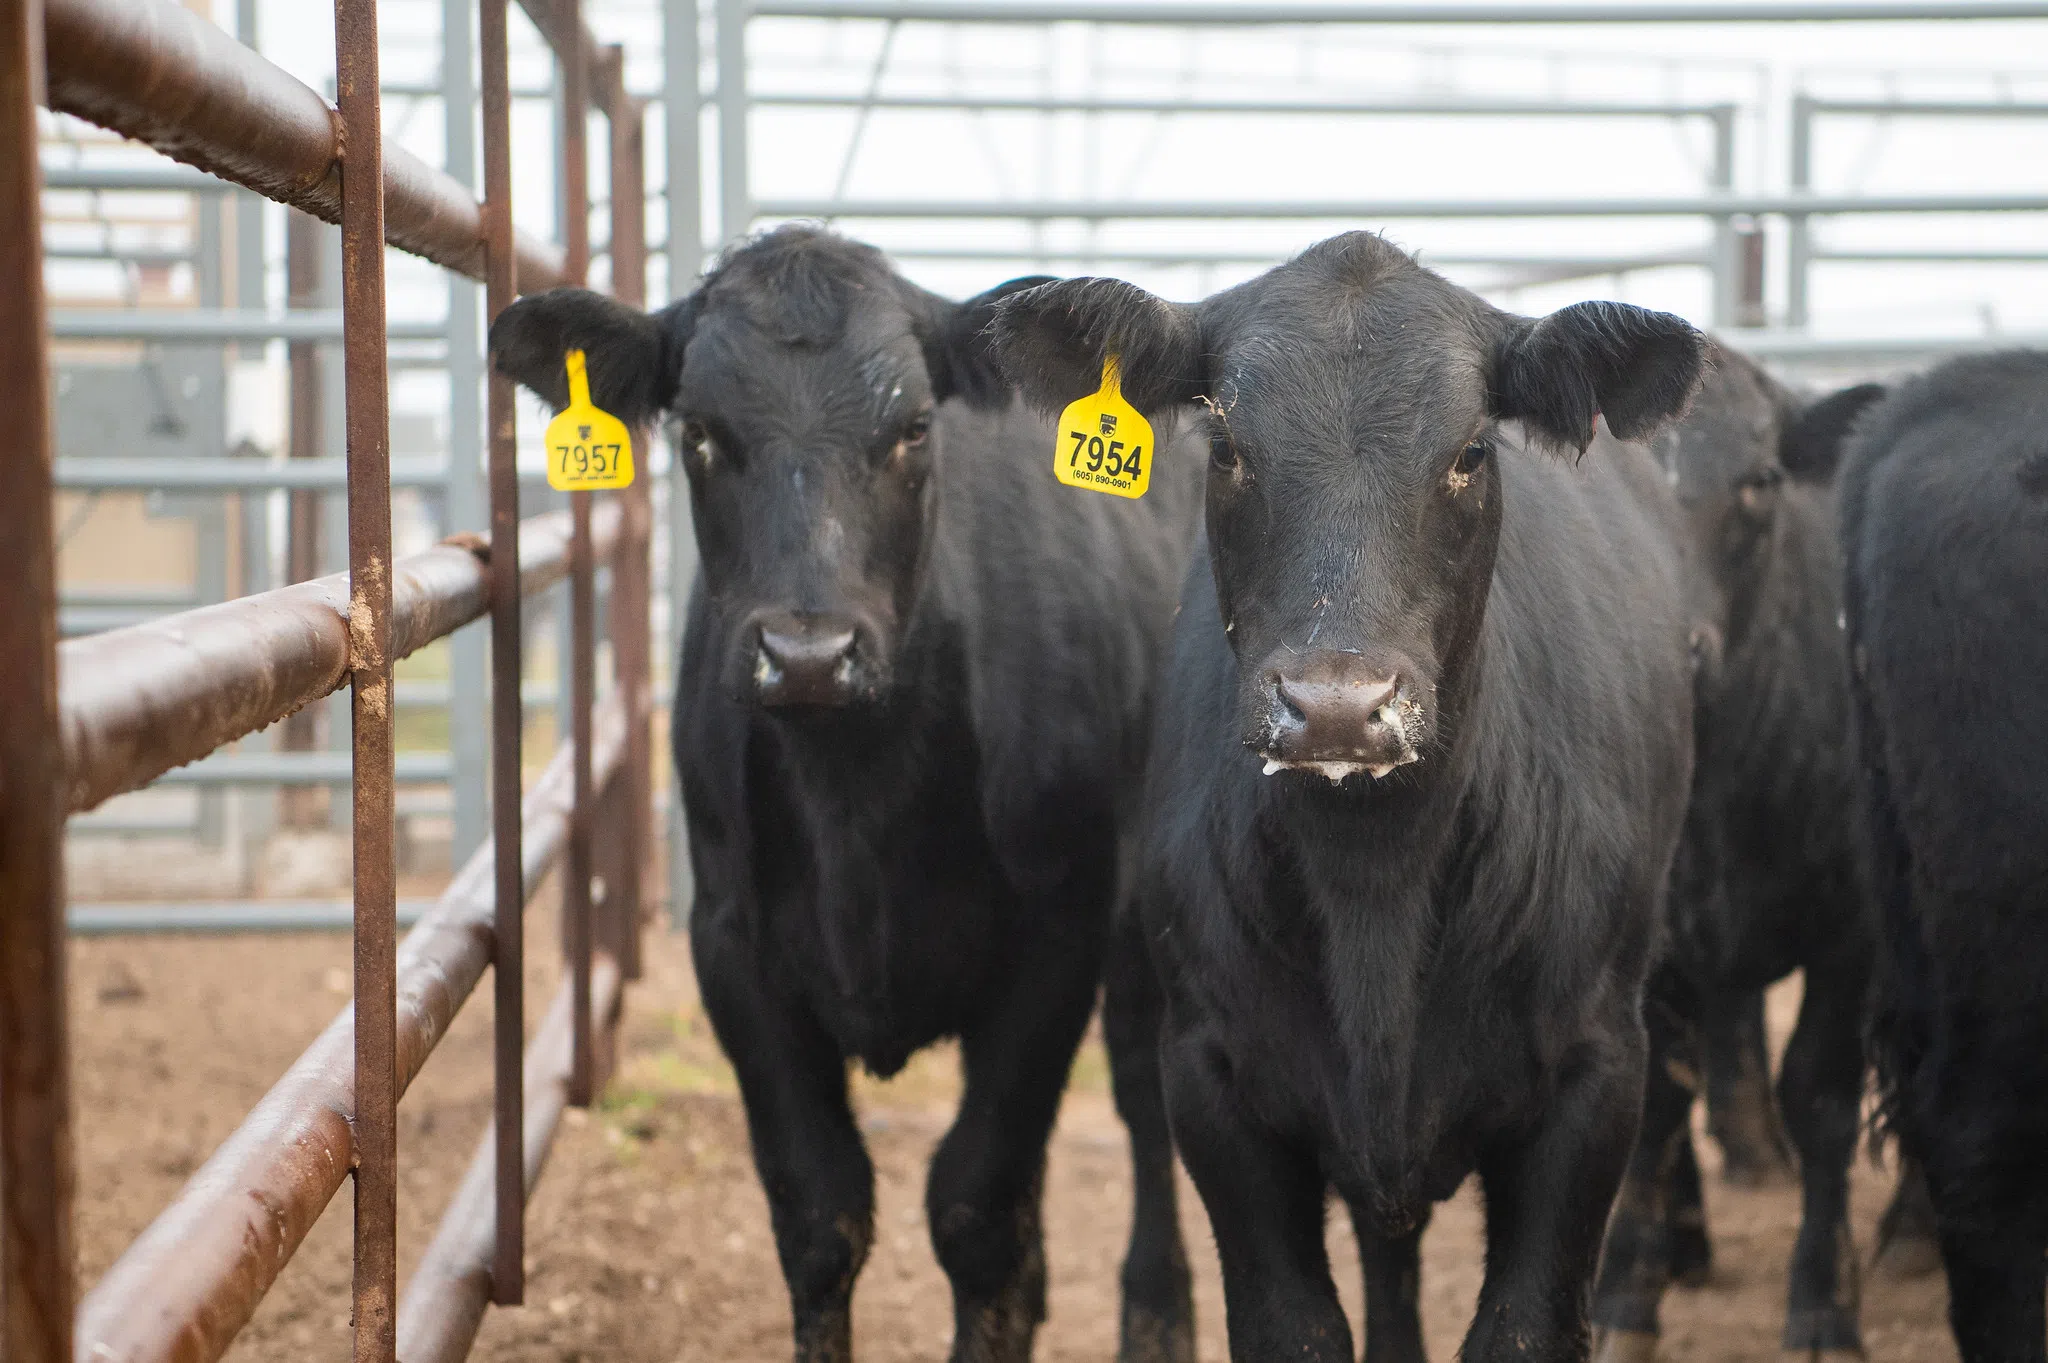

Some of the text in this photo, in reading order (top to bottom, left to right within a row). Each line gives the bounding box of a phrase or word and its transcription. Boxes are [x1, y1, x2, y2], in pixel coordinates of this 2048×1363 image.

[556, 444, 621, 473] 7957
[1070, 431, 1142, 481] 7954
[1072, 469, 1132, 490] (605) 890-0901
